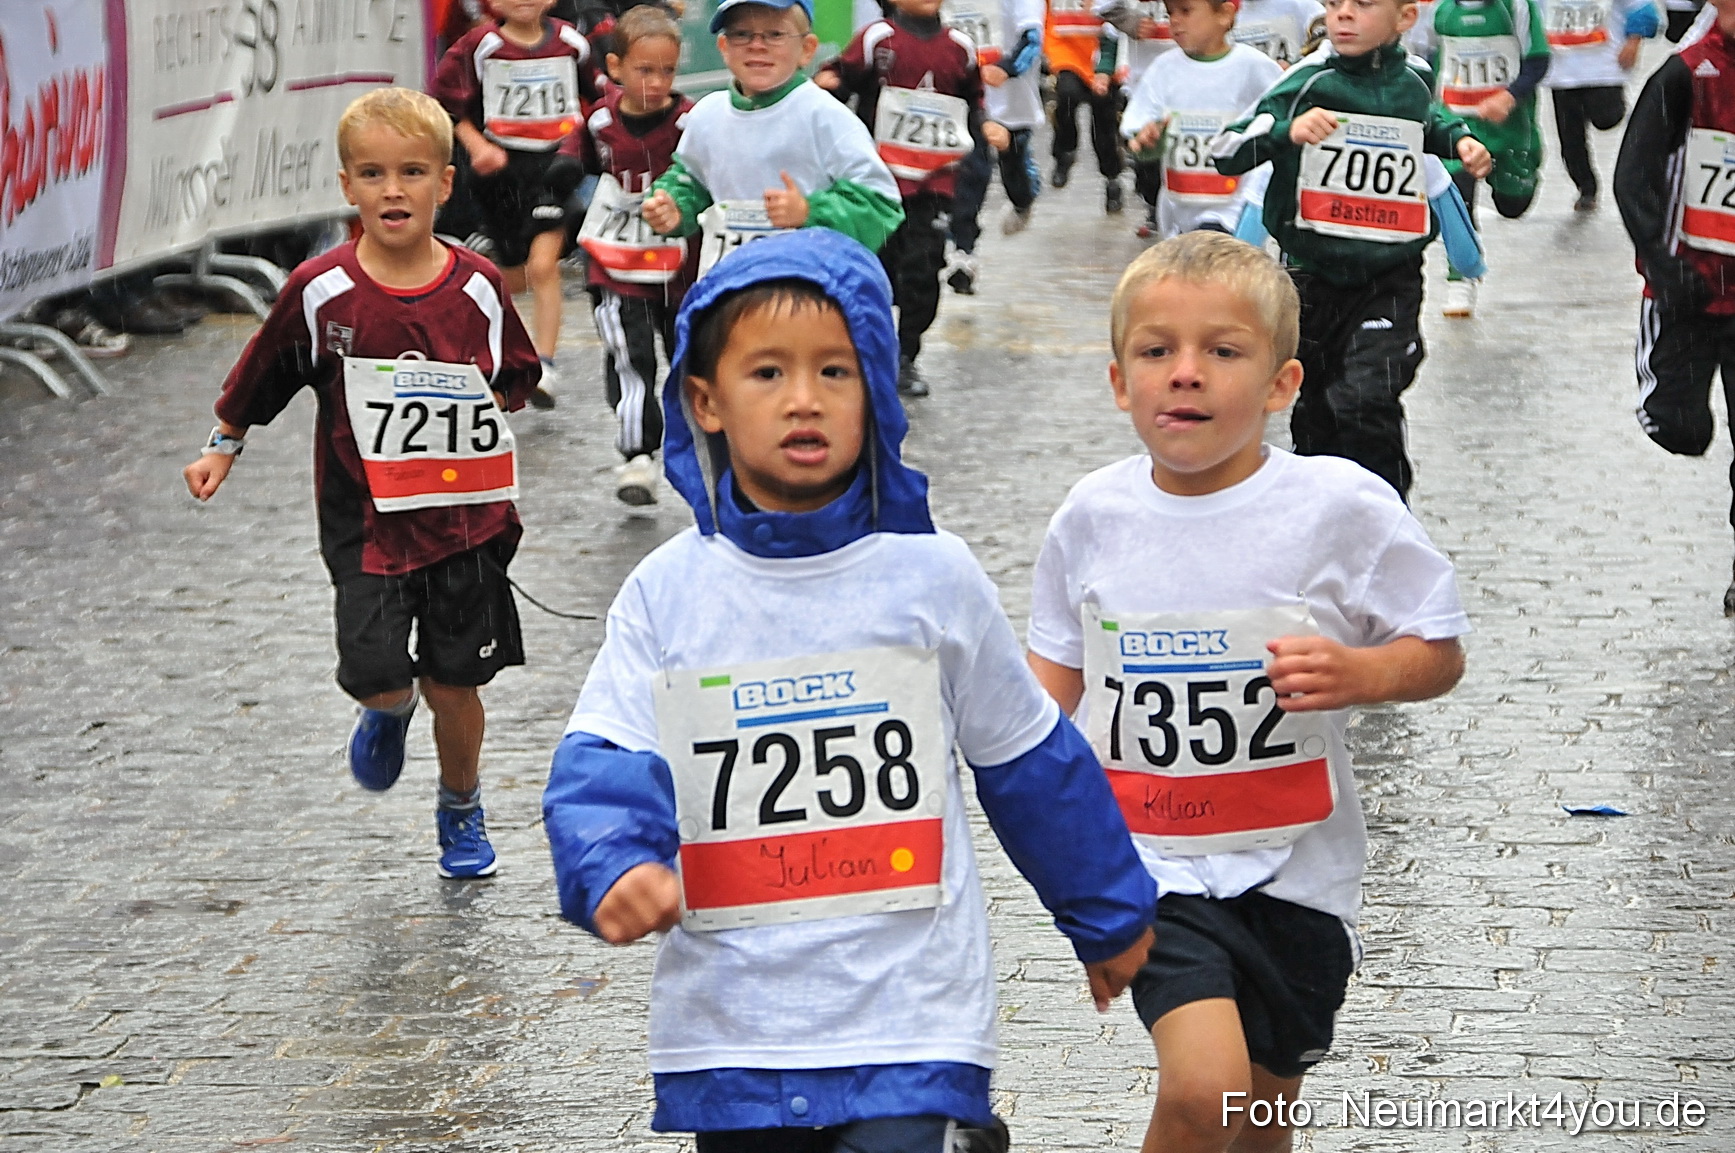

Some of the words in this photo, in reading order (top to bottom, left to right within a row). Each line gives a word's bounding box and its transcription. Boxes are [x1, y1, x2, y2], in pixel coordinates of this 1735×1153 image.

[496, 82, 566, 115] 7219
[1320, 144, 1418, 197] 7062
[600, 203, 643, 243] 721
[1330, 199, 1400, 226] Bastian
[394, 371, 468, 390] BOCK
[366, 401, 500, 454] 7215
[1120, 630, 1230, 657] BOCK
[733, 671, 856, 710] BOCK
[1104, 676, 1297, 767] 7352
[693, 719, 920, 831] 7258
[1143, 784, 1215, 821] Kilian
[759, 837, 877, 889] Julian
